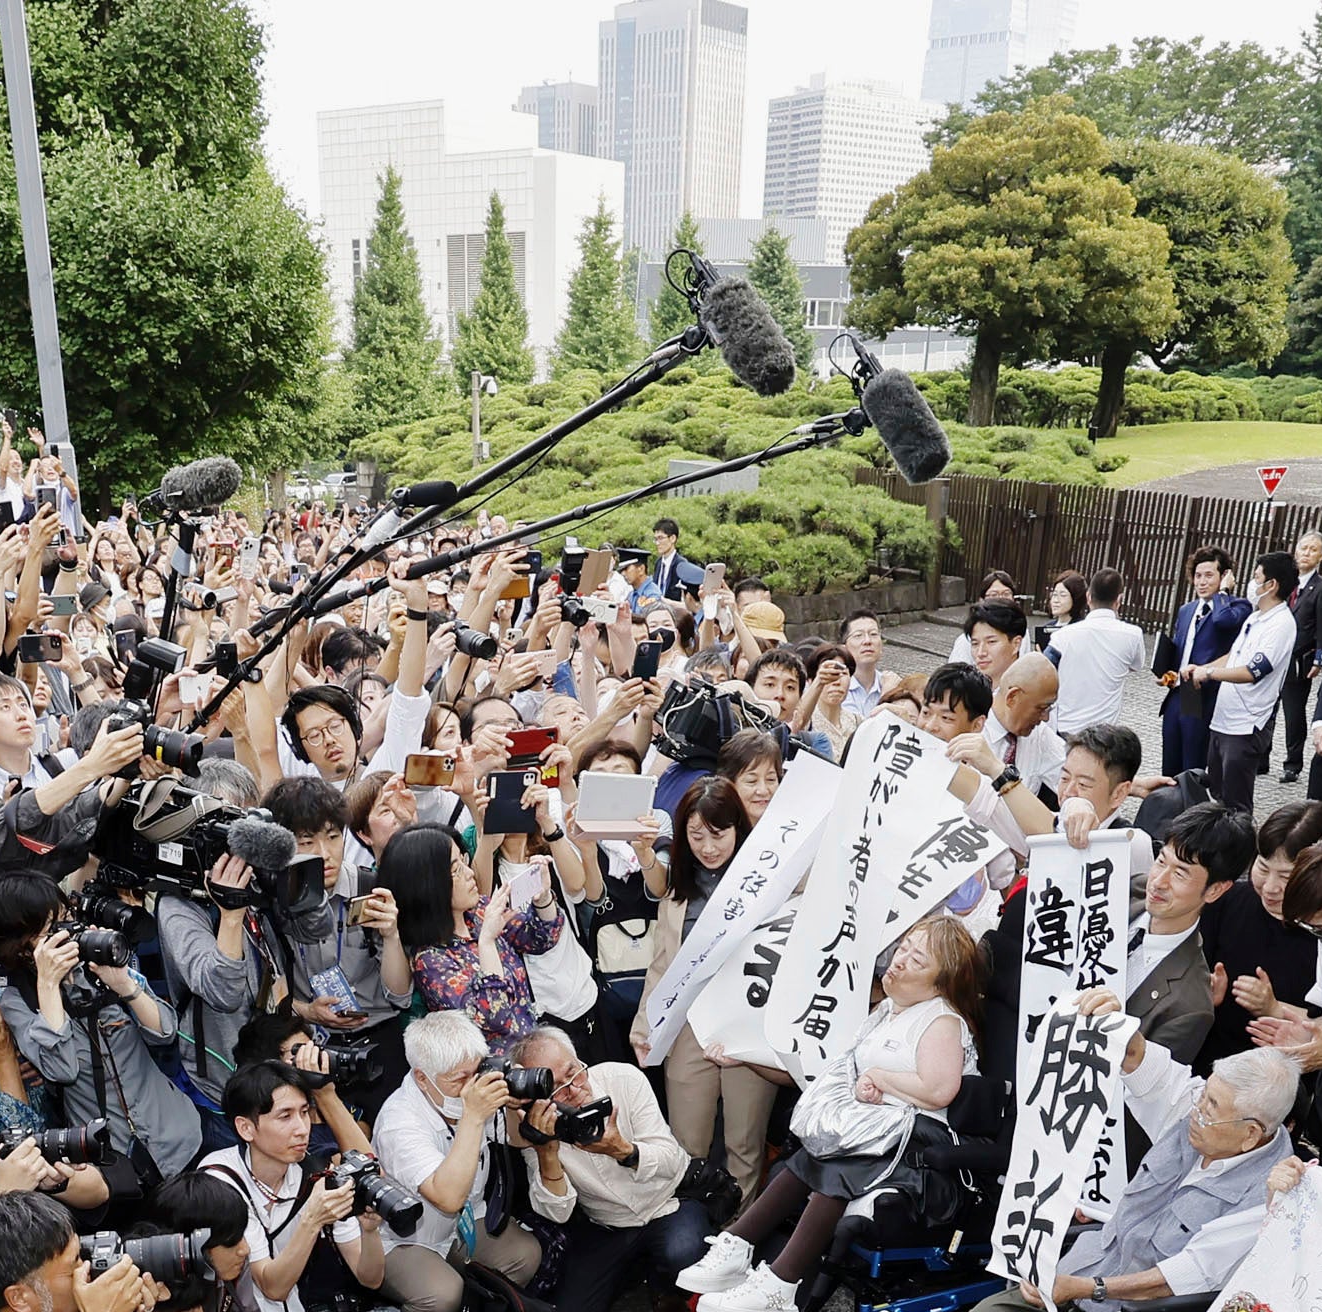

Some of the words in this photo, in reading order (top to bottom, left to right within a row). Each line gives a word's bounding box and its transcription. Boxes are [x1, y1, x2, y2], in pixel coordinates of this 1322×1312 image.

[792, 724, 923, 1082] 障がい者の声が届い
[1003, 1012, 1127, 1289] 勝訴
